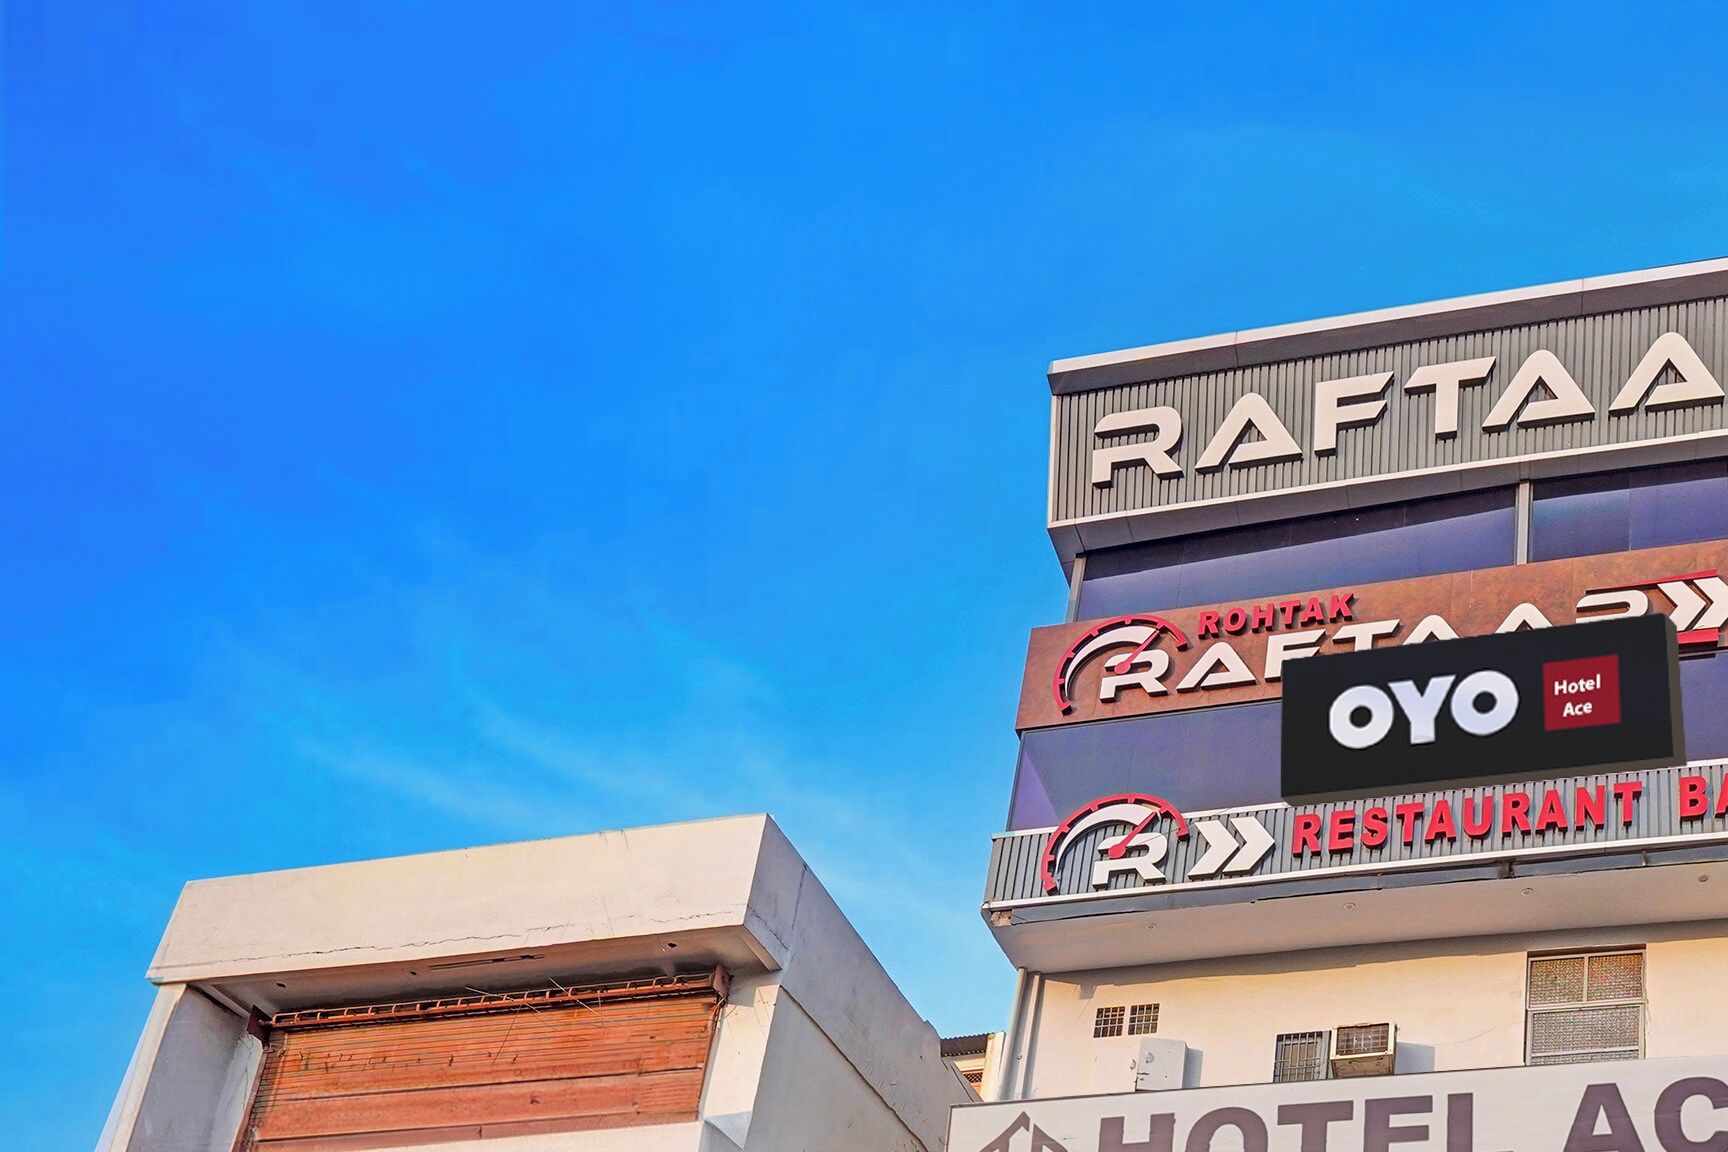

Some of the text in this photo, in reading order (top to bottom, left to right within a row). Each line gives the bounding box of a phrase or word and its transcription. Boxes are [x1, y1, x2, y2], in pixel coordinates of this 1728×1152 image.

[1198, 592, 1354, 640] ROHTAK
[1329, 669, 1602, 749] OYO Hotel
[1562, 701, 1593, 718] Ace
[1291, 780, 1643, 857] RESTAURANT
